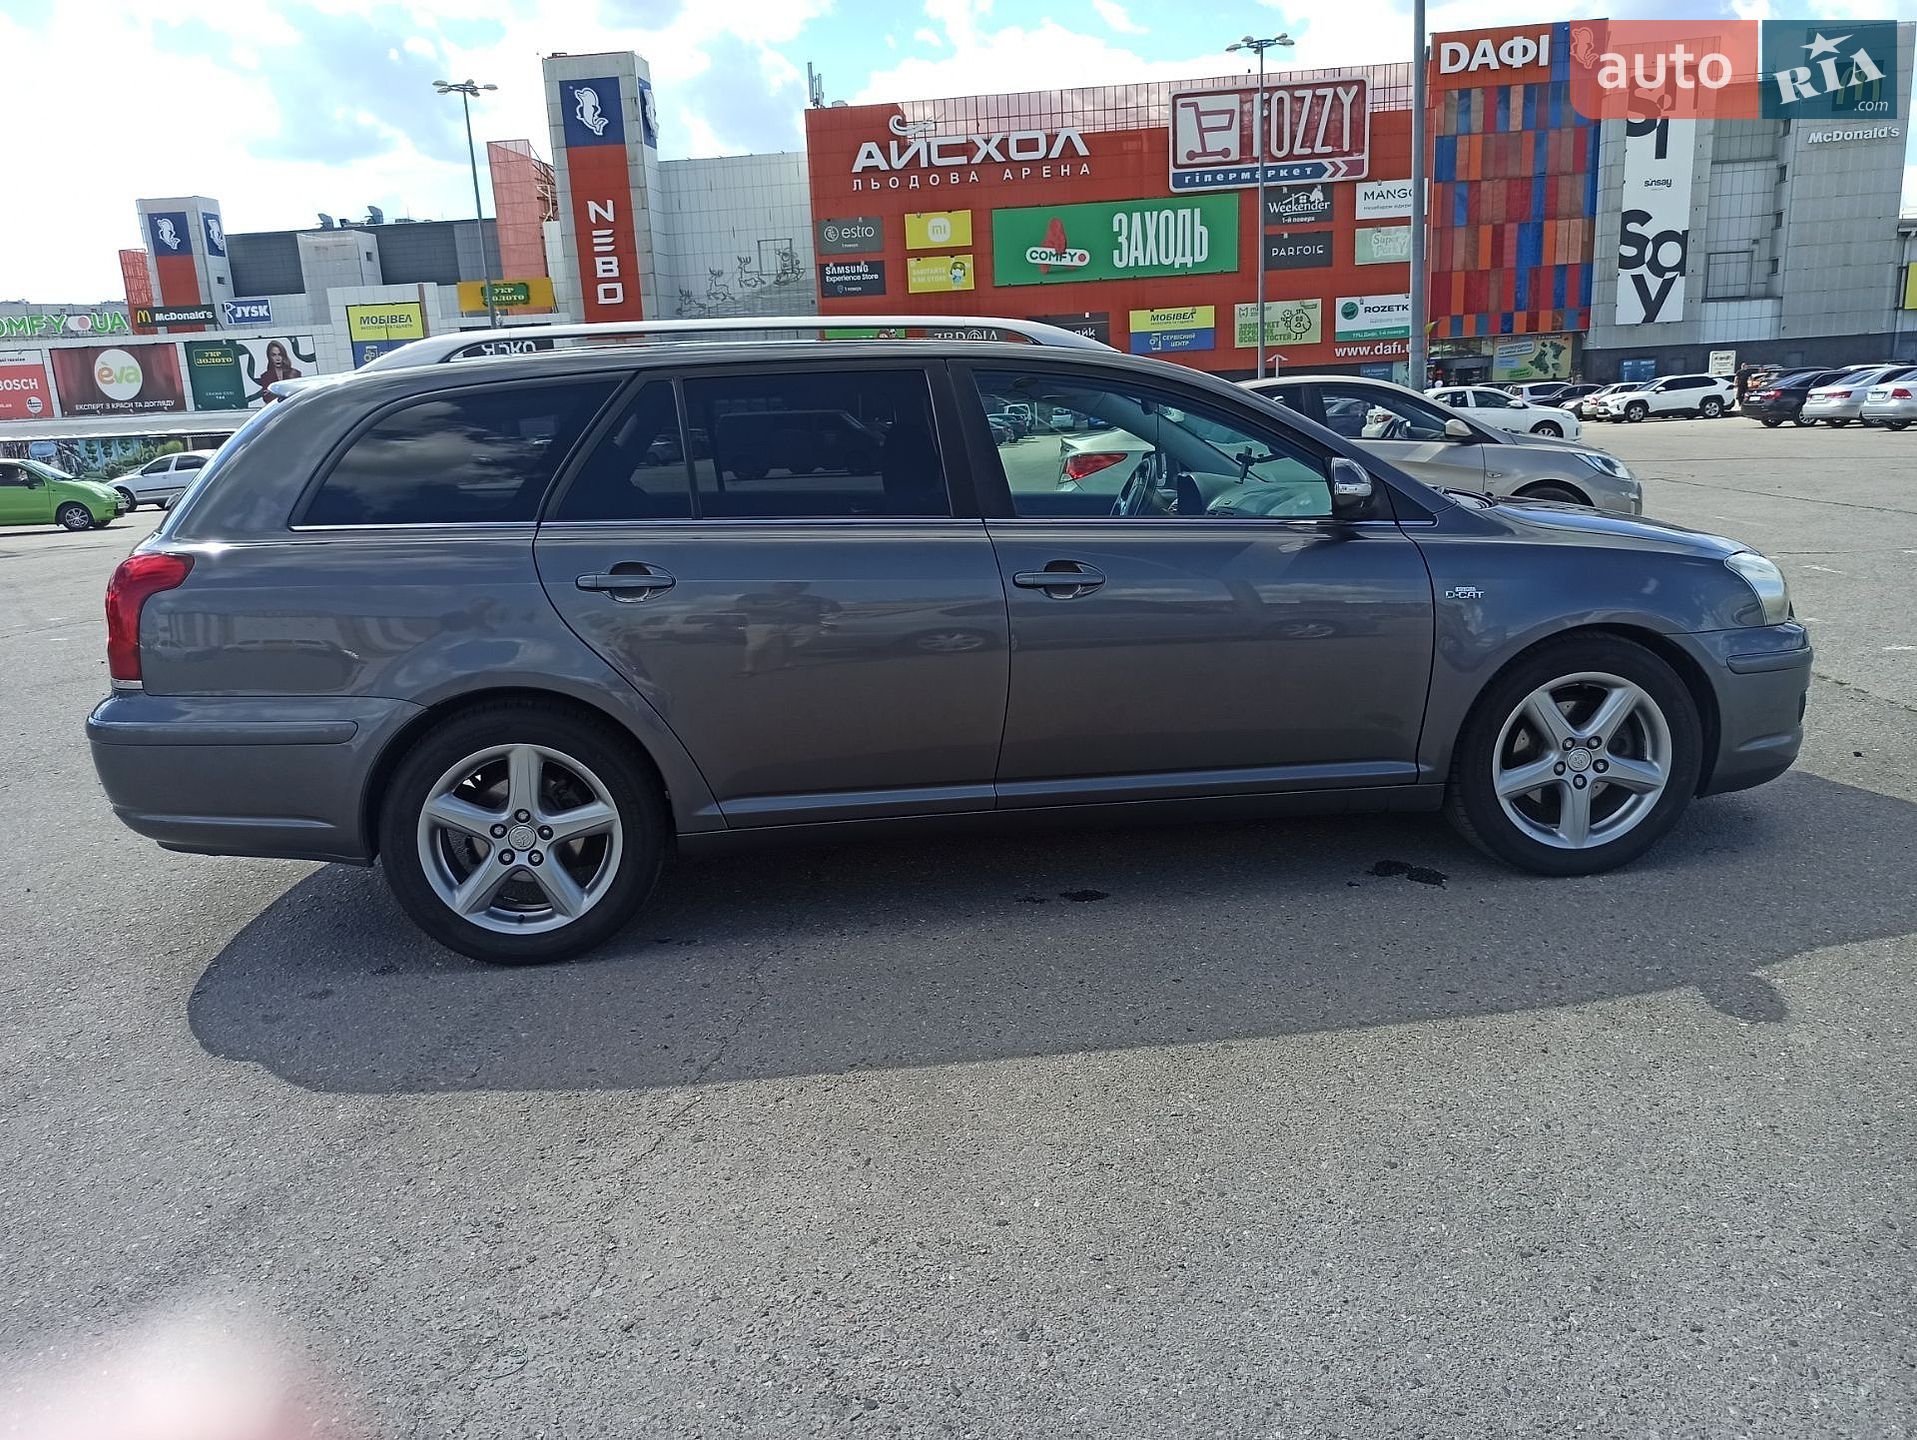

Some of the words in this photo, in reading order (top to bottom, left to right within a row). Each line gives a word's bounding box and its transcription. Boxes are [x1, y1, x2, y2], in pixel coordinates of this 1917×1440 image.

[1253, 84, 1359, 158] FOZZY
[1808, 126, 1900, 144] McDonald's
[852, 170, 980, 192] ЛЬОДОВА
[1003, 163, 1090, 182] АРЕНА
[1644, 178, 1672, 188] sinsay
[1268, 198, 1331, 214] Weekender
[841, 225, 875, 239] estro
[1112, 207, 1209, 269] ЗАХОДЬ
[1029, 249, 1078, 262] COMFY
[825, 264, 869, 275] SAMSUNG
[826, 275, 862, 284] Experience
[862, 273, 879, 281] Store
[485, 294, 525, 302] ОЛОТО
[235, 305, 270, 318] JYSK
[1364, 304, 1409, 314] ROZETK
[155, 310, 214, 321] McDonald's
[360, 314, 412, 325] МОБІВЕЛ
[1150, 312, 1195, 322] МОБІВЕЛ
[91, 311, 128, 333] UA
[75, 402, 104, 411] ЕКСПЕРТ
[111, 401, 134, 409] КРАСИ
[134, 400, 143, 408] ТА
[143, 399, 175, 408] ДОГЛЯДУ
[1446, 591, 1484, 599] D-CAT
